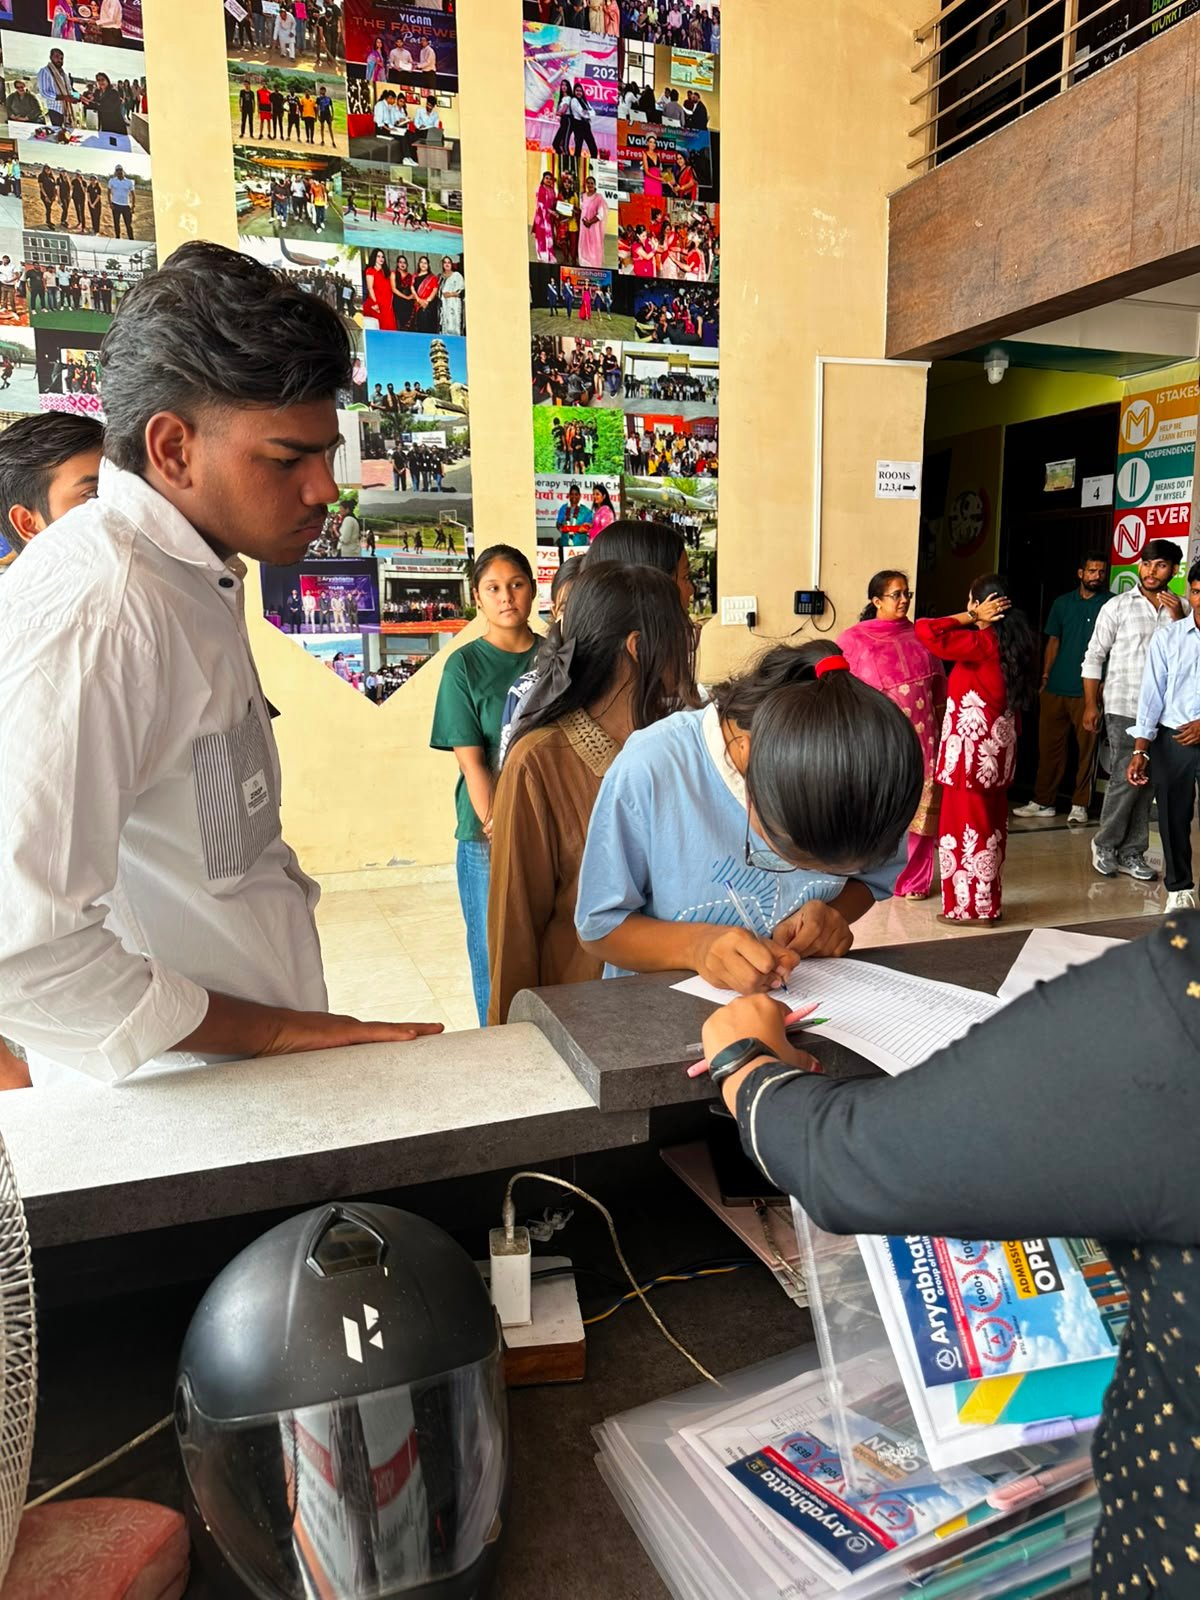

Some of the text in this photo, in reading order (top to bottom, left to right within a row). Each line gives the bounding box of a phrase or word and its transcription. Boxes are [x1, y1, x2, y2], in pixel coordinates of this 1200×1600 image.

[352, 16, 385, 29] THE
[400, 13, 432, 26] VIGAM
[1125, 405, 1150, 441] M
[878, 471, 911, 480] ROOMS
[878, 482, 901, 492] 1,2,3,4
[1155, 481, 1175, 491] MEANS
[1176, 480, 1185, 489] DO
[1092, 486, 1100, 500] 4
[1163, 490, 1187, 500] MYSELF
[1117, 505, 1190, 554] N EVER
[931, 1266, 945, 1296] Group
[973, 1275, 989, 1307] 1000+
[789, 1442, 812, 1459] BEST
[760, 1468, 852, 1539] Aryabhatta
